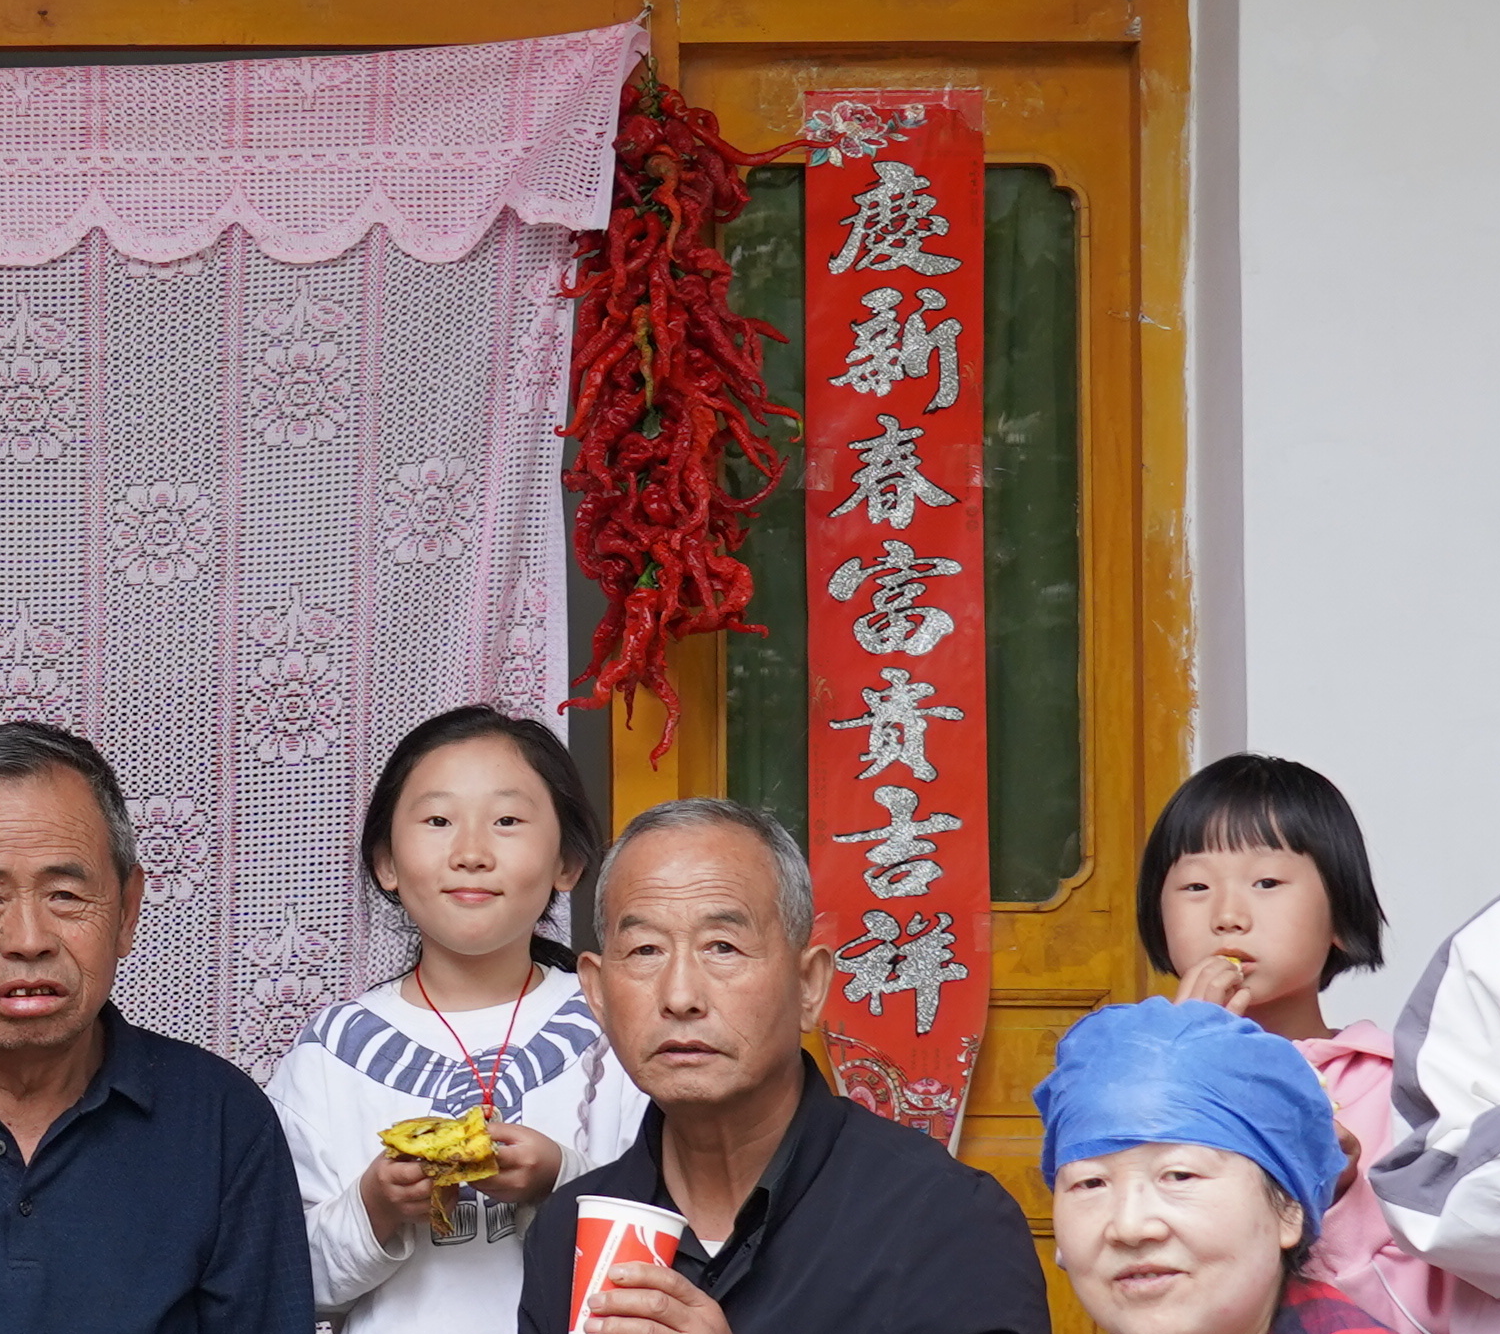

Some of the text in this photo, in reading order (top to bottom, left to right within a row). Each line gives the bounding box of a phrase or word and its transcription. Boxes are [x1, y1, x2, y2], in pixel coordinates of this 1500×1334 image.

[826, 160, 969, 1036] 慶新春富貴吉祥
